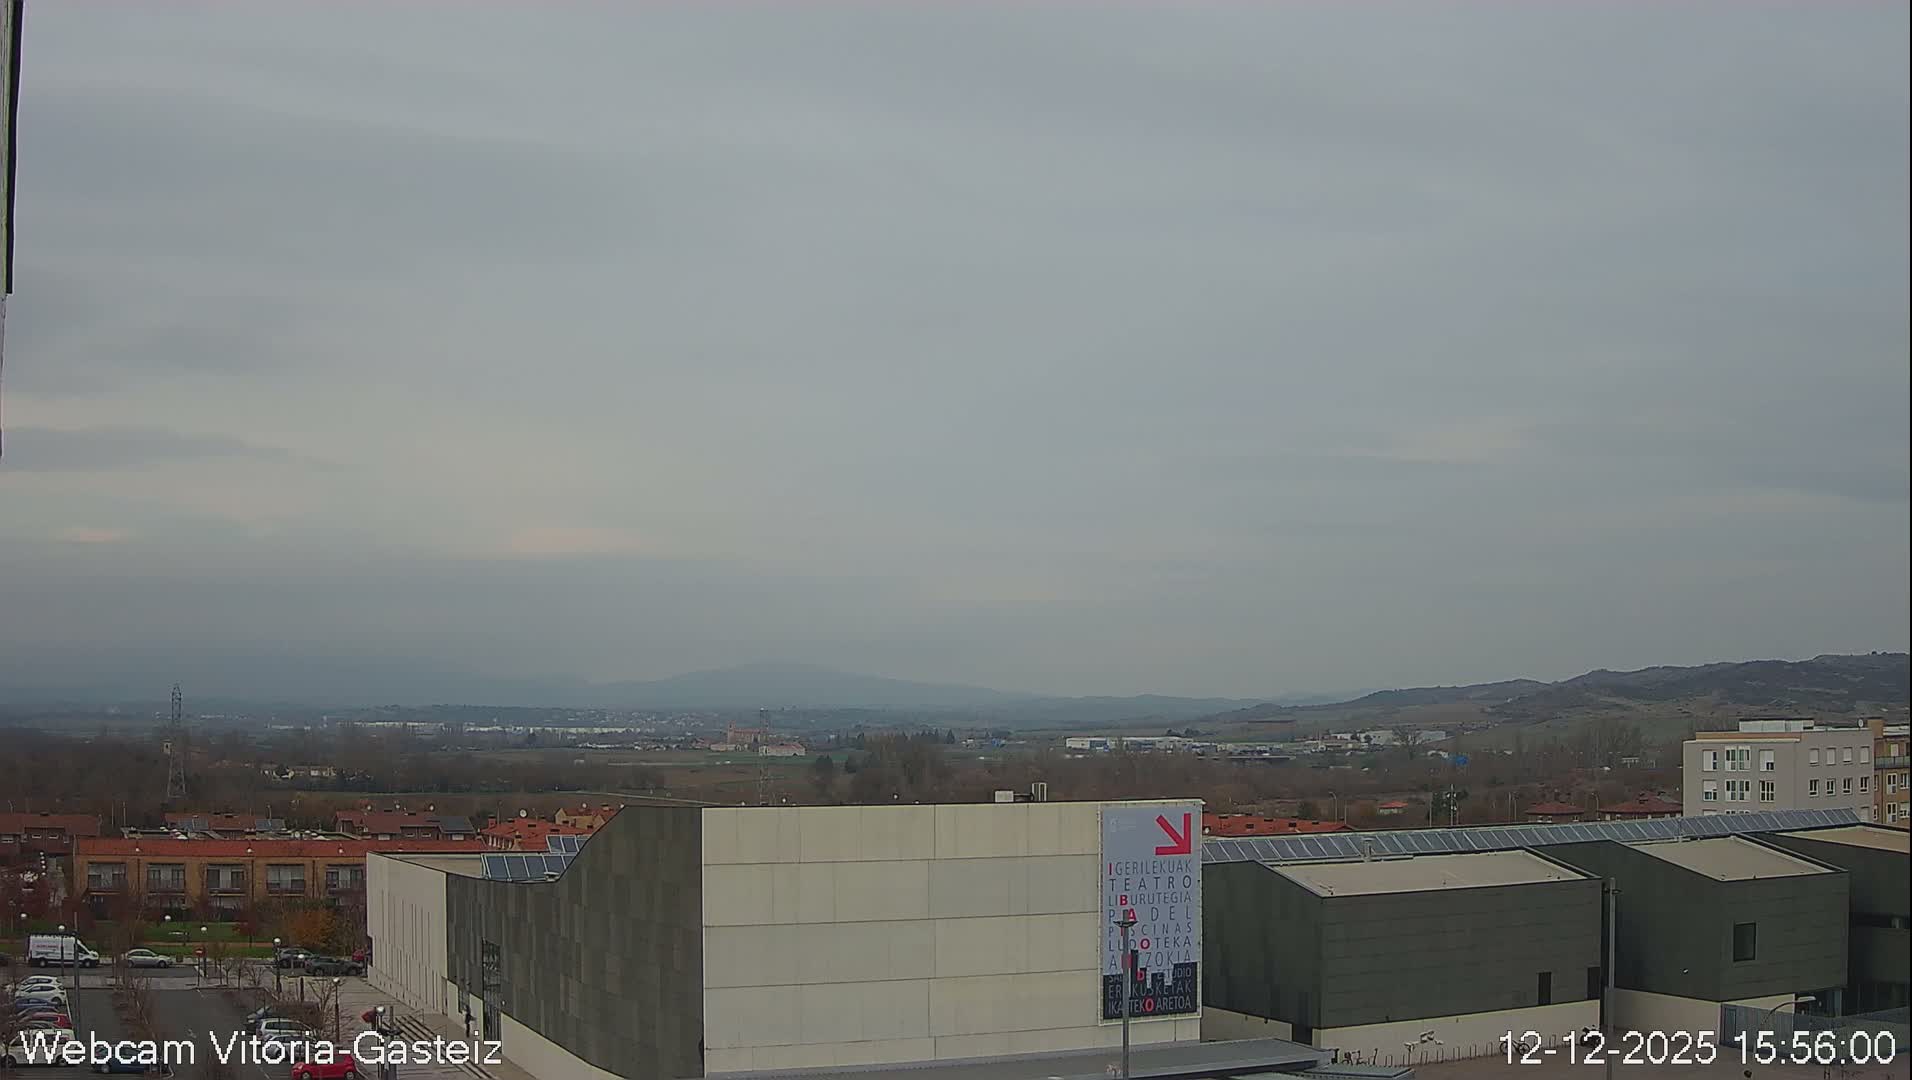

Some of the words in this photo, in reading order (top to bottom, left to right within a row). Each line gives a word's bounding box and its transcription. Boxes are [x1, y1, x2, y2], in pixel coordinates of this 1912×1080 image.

[1108, 860, 1192, 876] IGERILEKUAK
[1109, 875, 1192, 892] TEATRO
[1108, 891, 1192, 907] LIBURUTEGIA
[1108, 979, 1192, 999] ERKUSKETAK
[1108, 998, 1155, 1015] IKATEKO
[1156, 995, 1192, 1011] ARETOA
